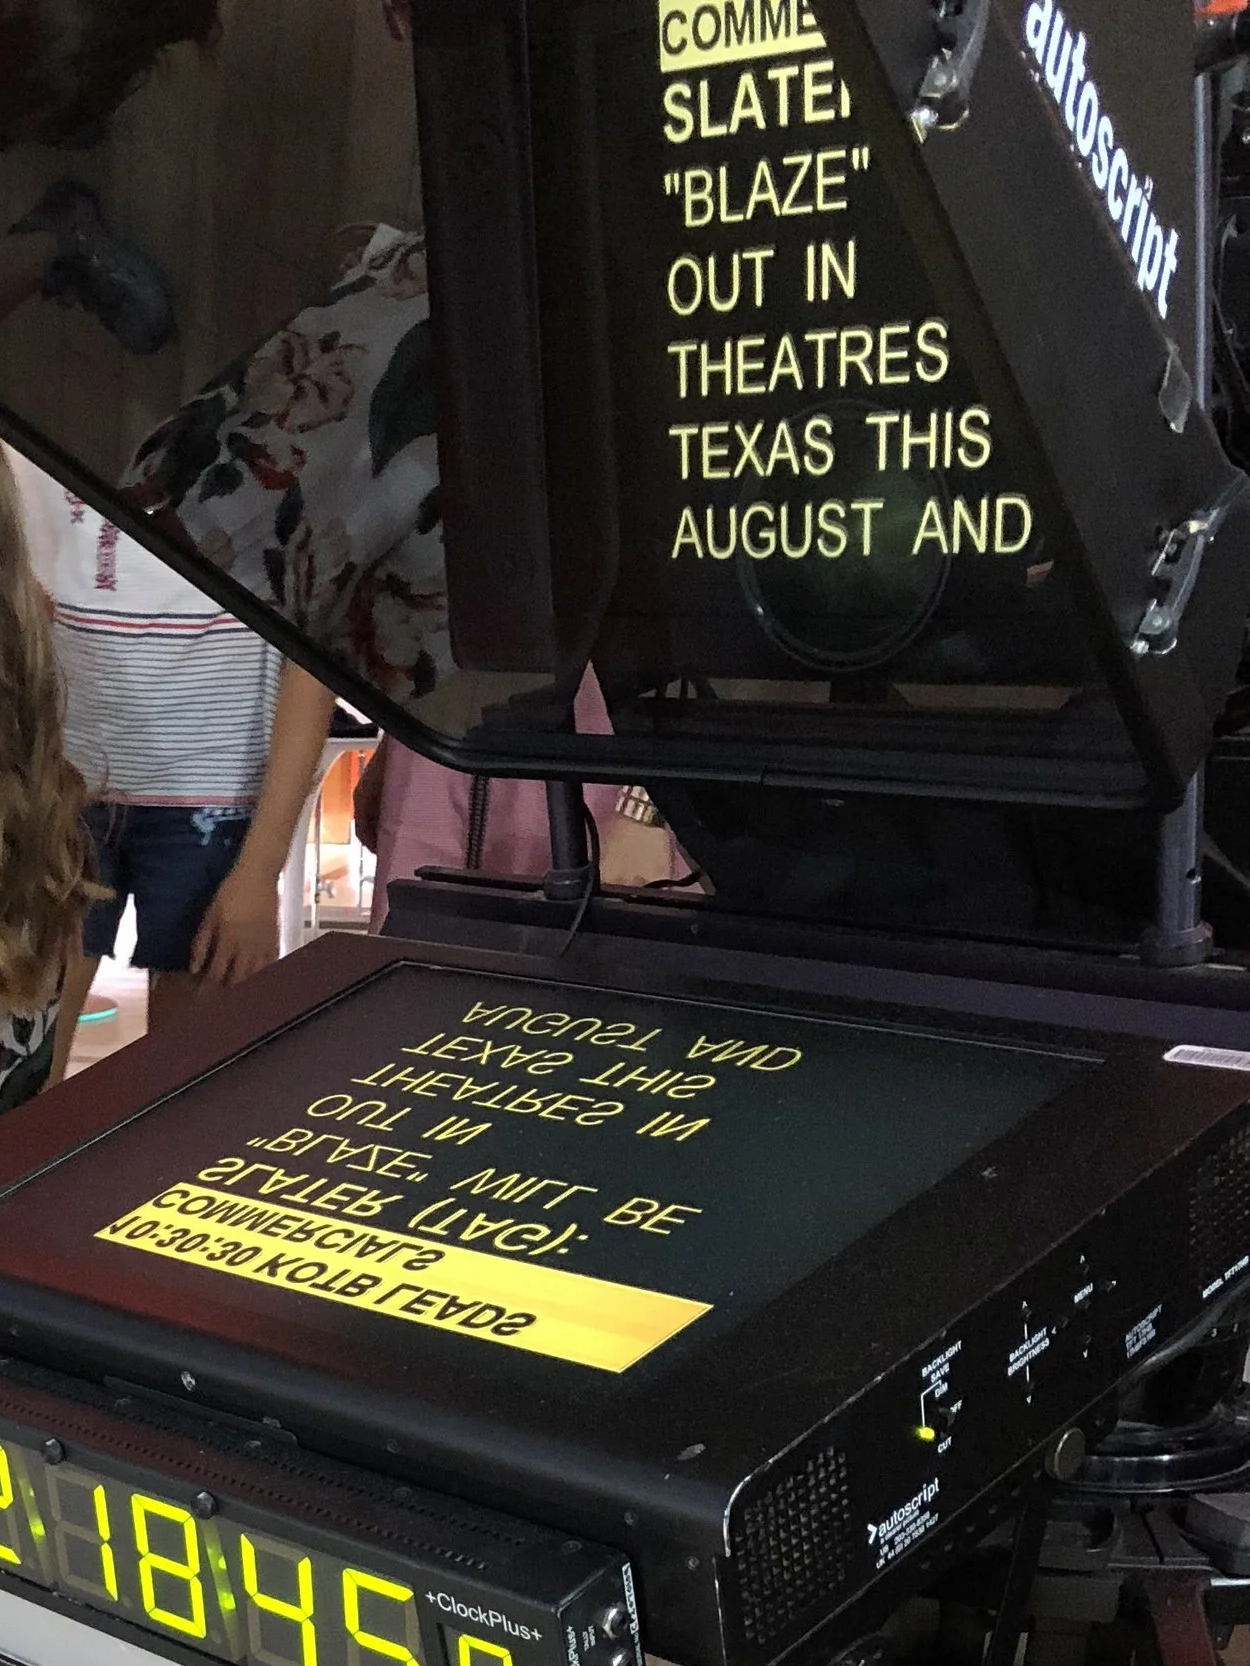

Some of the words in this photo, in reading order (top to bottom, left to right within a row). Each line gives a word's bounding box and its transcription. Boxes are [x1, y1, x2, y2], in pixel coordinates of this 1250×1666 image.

[664, 147, 869, 228] "BLAZE"
[1026, 0, 1179, 319] autoscript
[668, 249, 774, 316] OUT
[807, 240, 855, 302] IN
[668, 321, 949, 399] THEATRES
[669, 417, 834, 480] TEXAS
[866, 406, 991, 471] THIS
[671, 500, 883, 560] AUGUST
[913, 494, 1032, 555] AND
[1074, 1283, 1093, 1304] MENU
[922, 1340, 962, 1378] BACKLIGHT
[930, 1363, 950, 1383] SAVE
[1007, 1337, 1051, 1377] BRIGHTNESS
[1009, 1326, 1048, 1362] BACKLIGHT
[937, 1436, 952, 1453] CUT
[878, 1477, 940, 1537] autoscript
